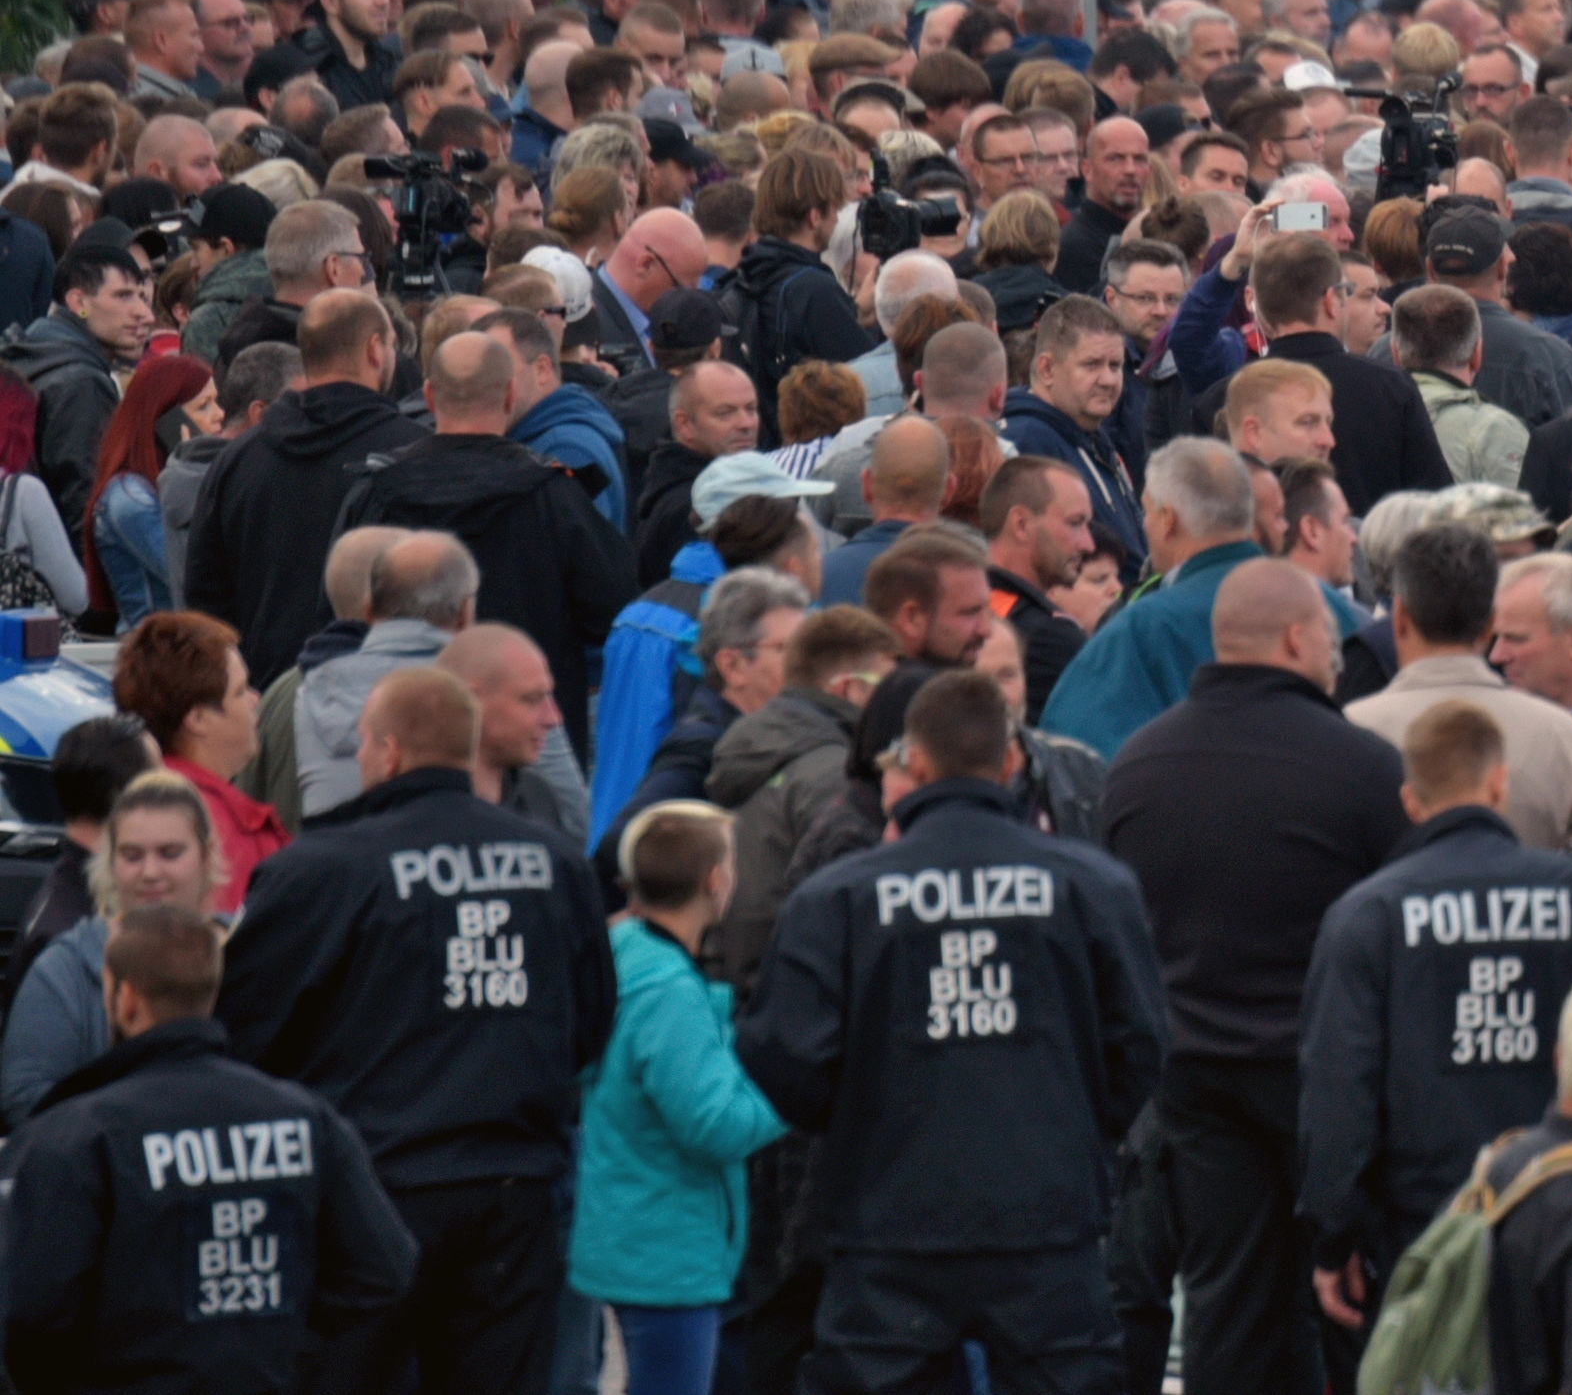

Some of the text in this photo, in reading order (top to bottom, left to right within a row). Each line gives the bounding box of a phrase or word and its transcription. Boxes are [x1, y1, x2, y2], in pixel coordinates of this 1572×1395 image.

[390, 841, 553, 900] POLIZEI
[876, 865, 1054, 926] POLIZEI
[456, 899, 511, 938] BP
[1402, 887, 1572, 947] POLIZEI
[447, 933, 525, 973] BLU
[940, 928, 997, 967] BP
[443, 969, 529, 1009] 3160
[930, 962, 1012, 1004] BLU
[1469, 957, 1524, 994] BP
[927, 997, 1017, 1040] 3160
[1456, 990, 1536, 1029] BLU
[1452, 1025, 1539, 1064] 3160
[142, 1118, 313, 1191] POLIZEI
[212, 1198, 268, 1238] BP
[199, 1233, 279, 1277] BLU
[199, 1271, 281, 1316] 3231
